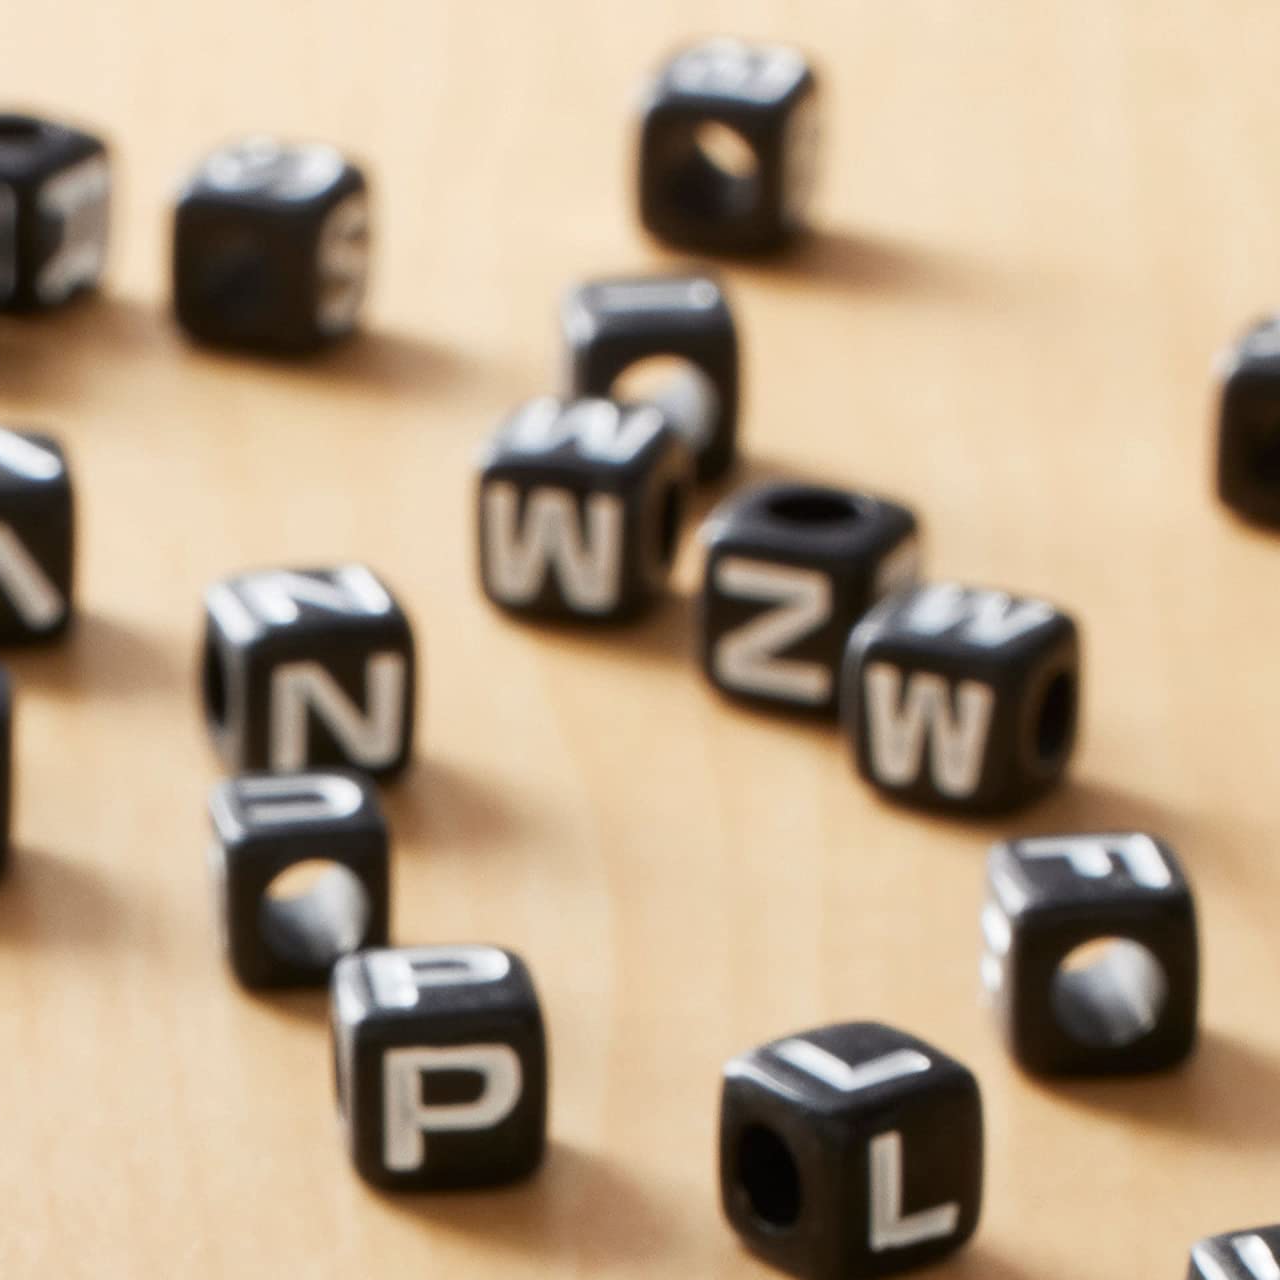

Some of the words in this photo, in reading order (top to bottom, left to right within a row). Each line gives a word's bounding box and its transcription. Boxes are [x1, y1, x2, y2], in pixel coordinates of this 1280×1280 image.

[270, 651, 407, 772] N
[865, 663, 996, 800] W
[365, 945, 511, 1010] P
[383, 1042, 523, 1173] P
[775, 1037, 933, 1092] L
[869, 1130, 960, 1252] L
